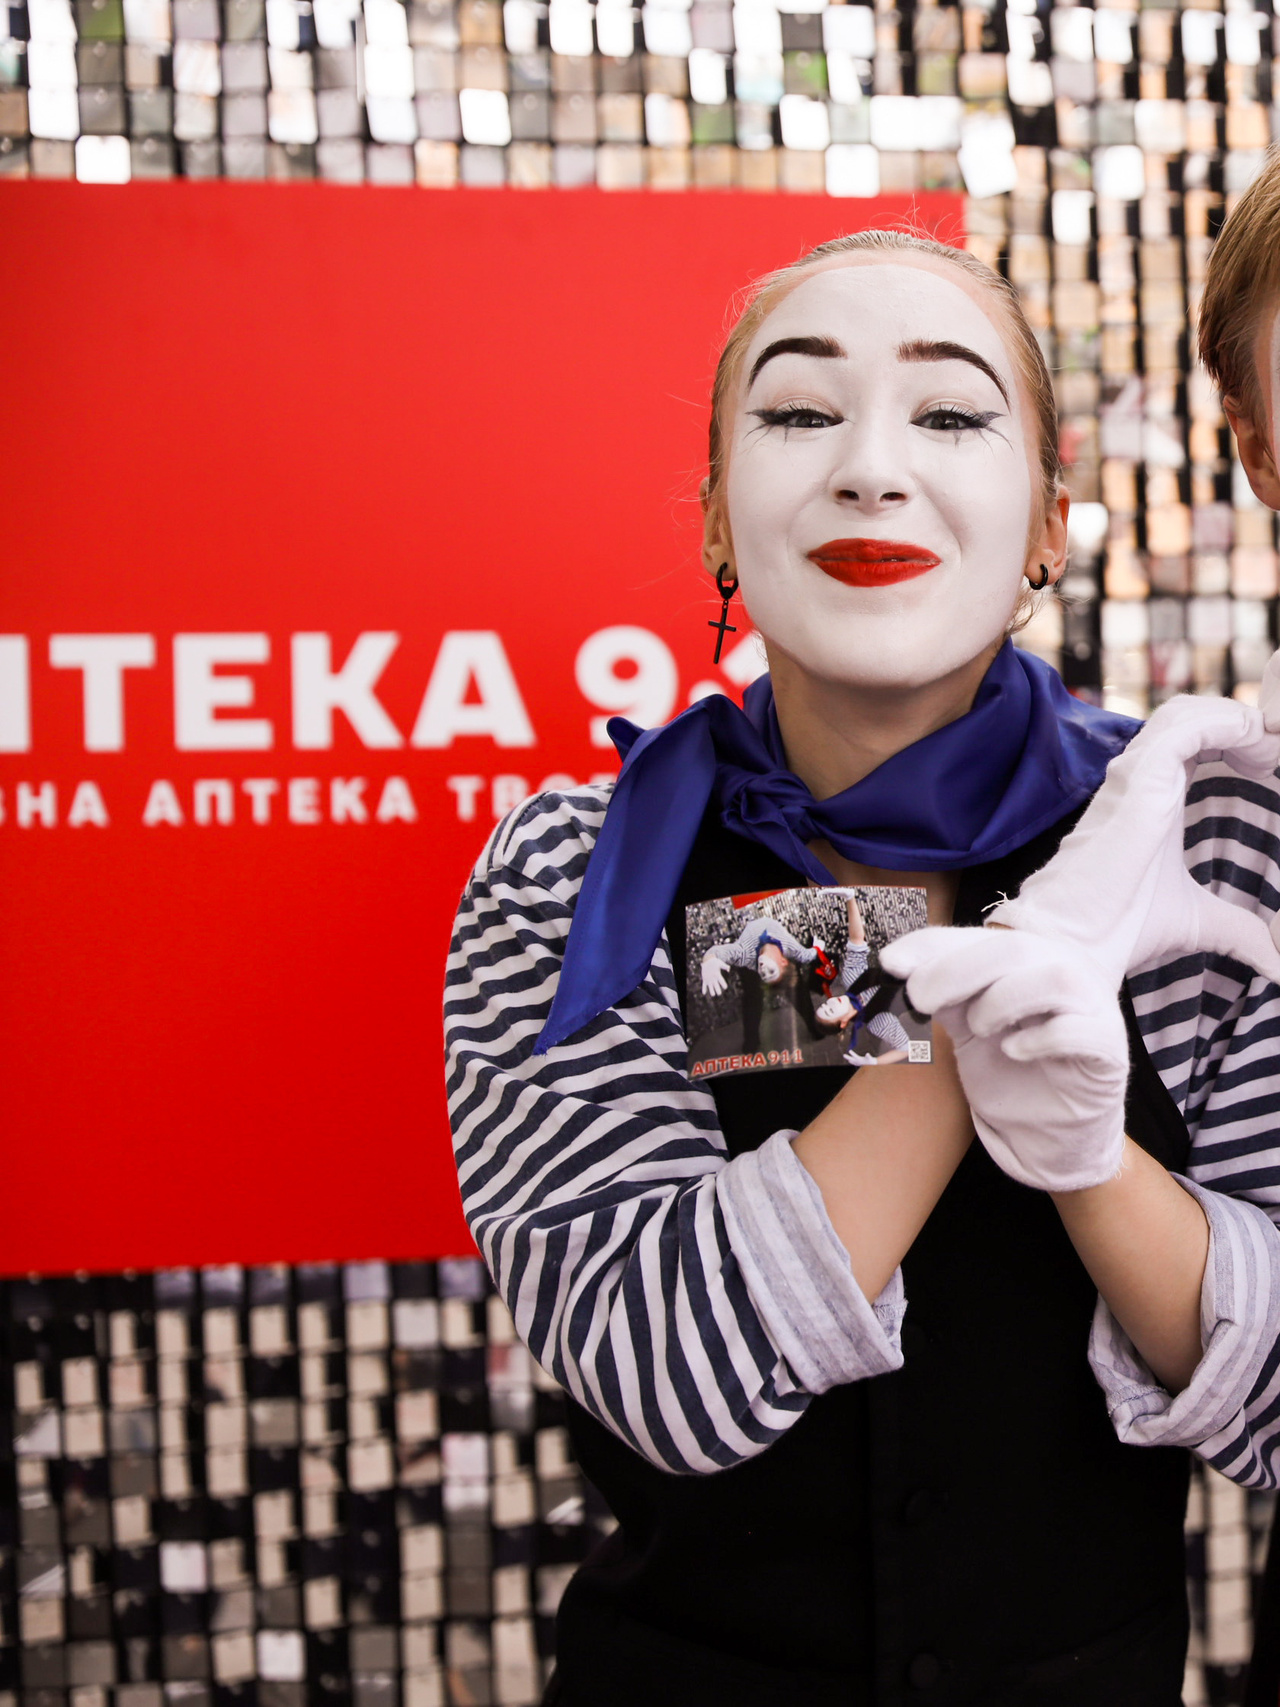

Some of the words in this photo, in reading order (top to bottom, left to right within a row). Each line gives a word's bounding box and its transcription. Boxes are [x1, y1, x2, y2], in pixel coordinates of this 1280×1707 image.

[0, 630, 536, 752] ТЕКА
[0, 779, 109, 829] НА
[142, 774, 418, 828] АПТЕКА
[691, 1052, 767, 1076] АПТЕКА
